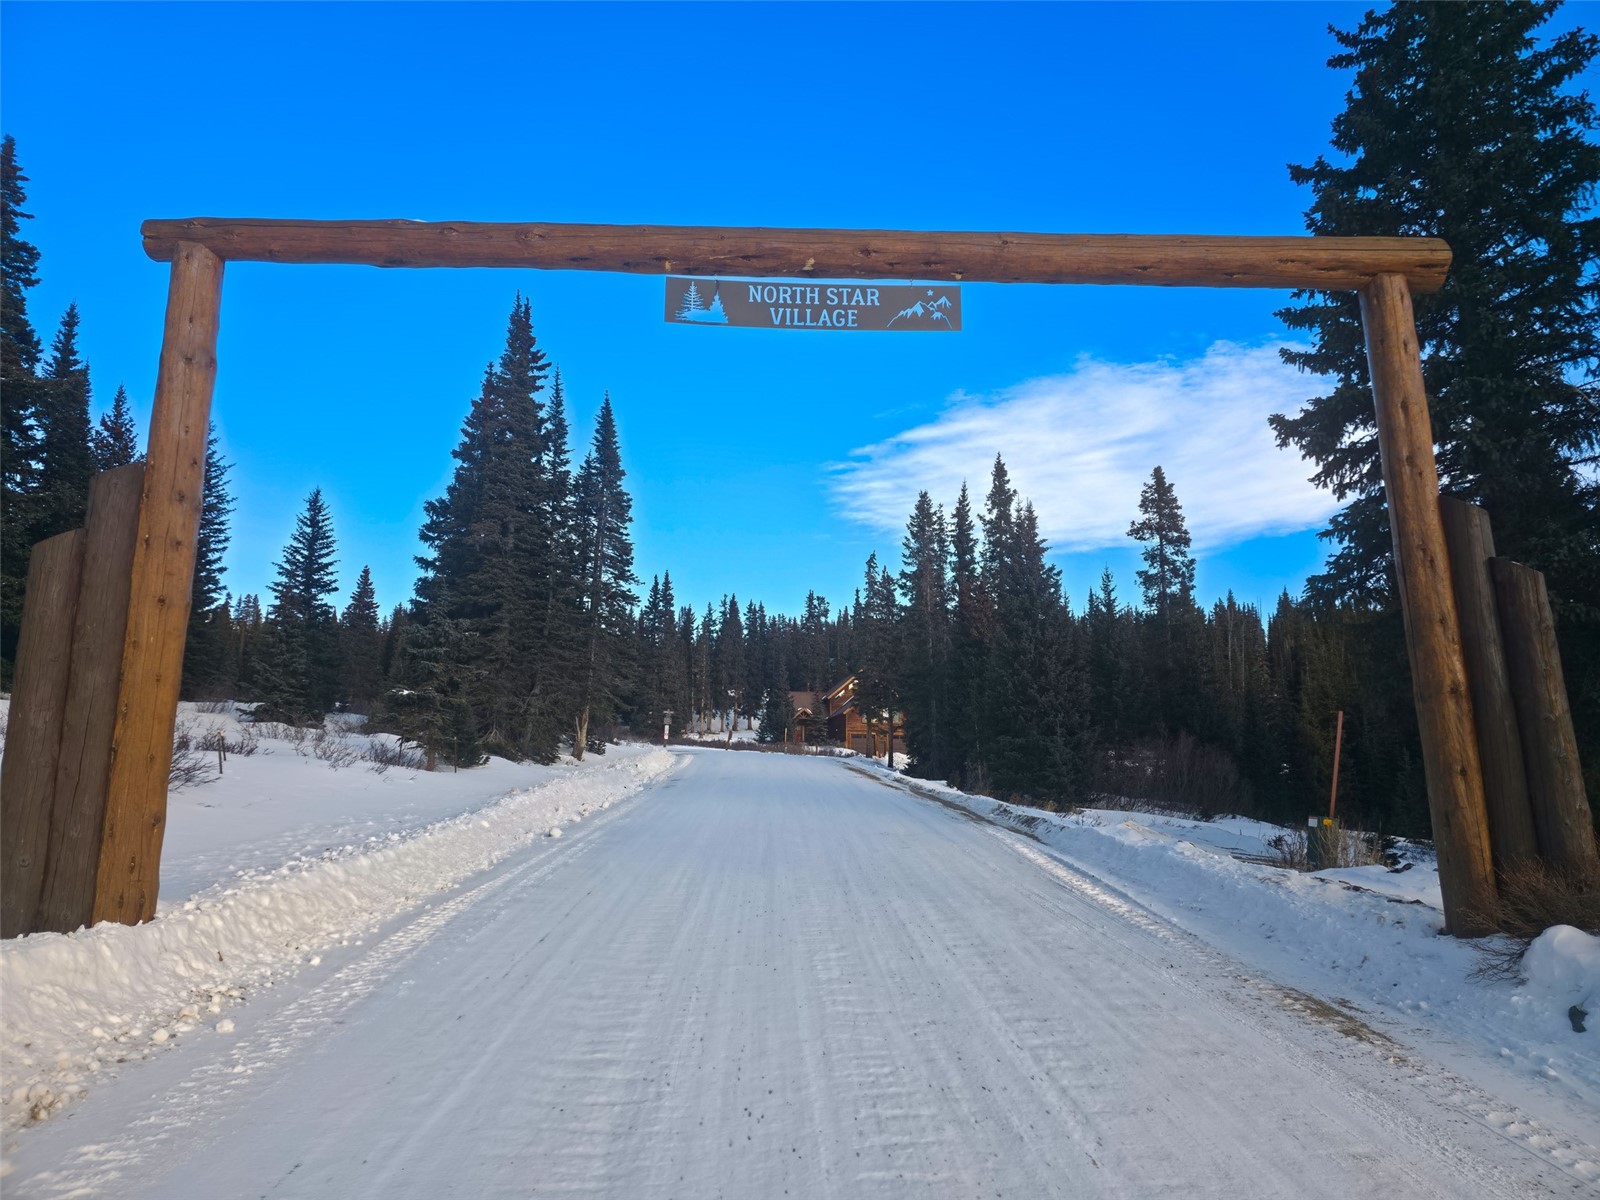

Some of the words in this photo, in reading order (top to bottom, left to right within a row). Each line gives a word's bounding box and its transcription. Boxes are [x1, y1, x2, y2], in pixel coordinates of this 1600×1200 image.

[748, 285, 820, 305] NORTH
[826, 287, 880, 306] STAR
[769, 307, 858, 327] VILLAGE
